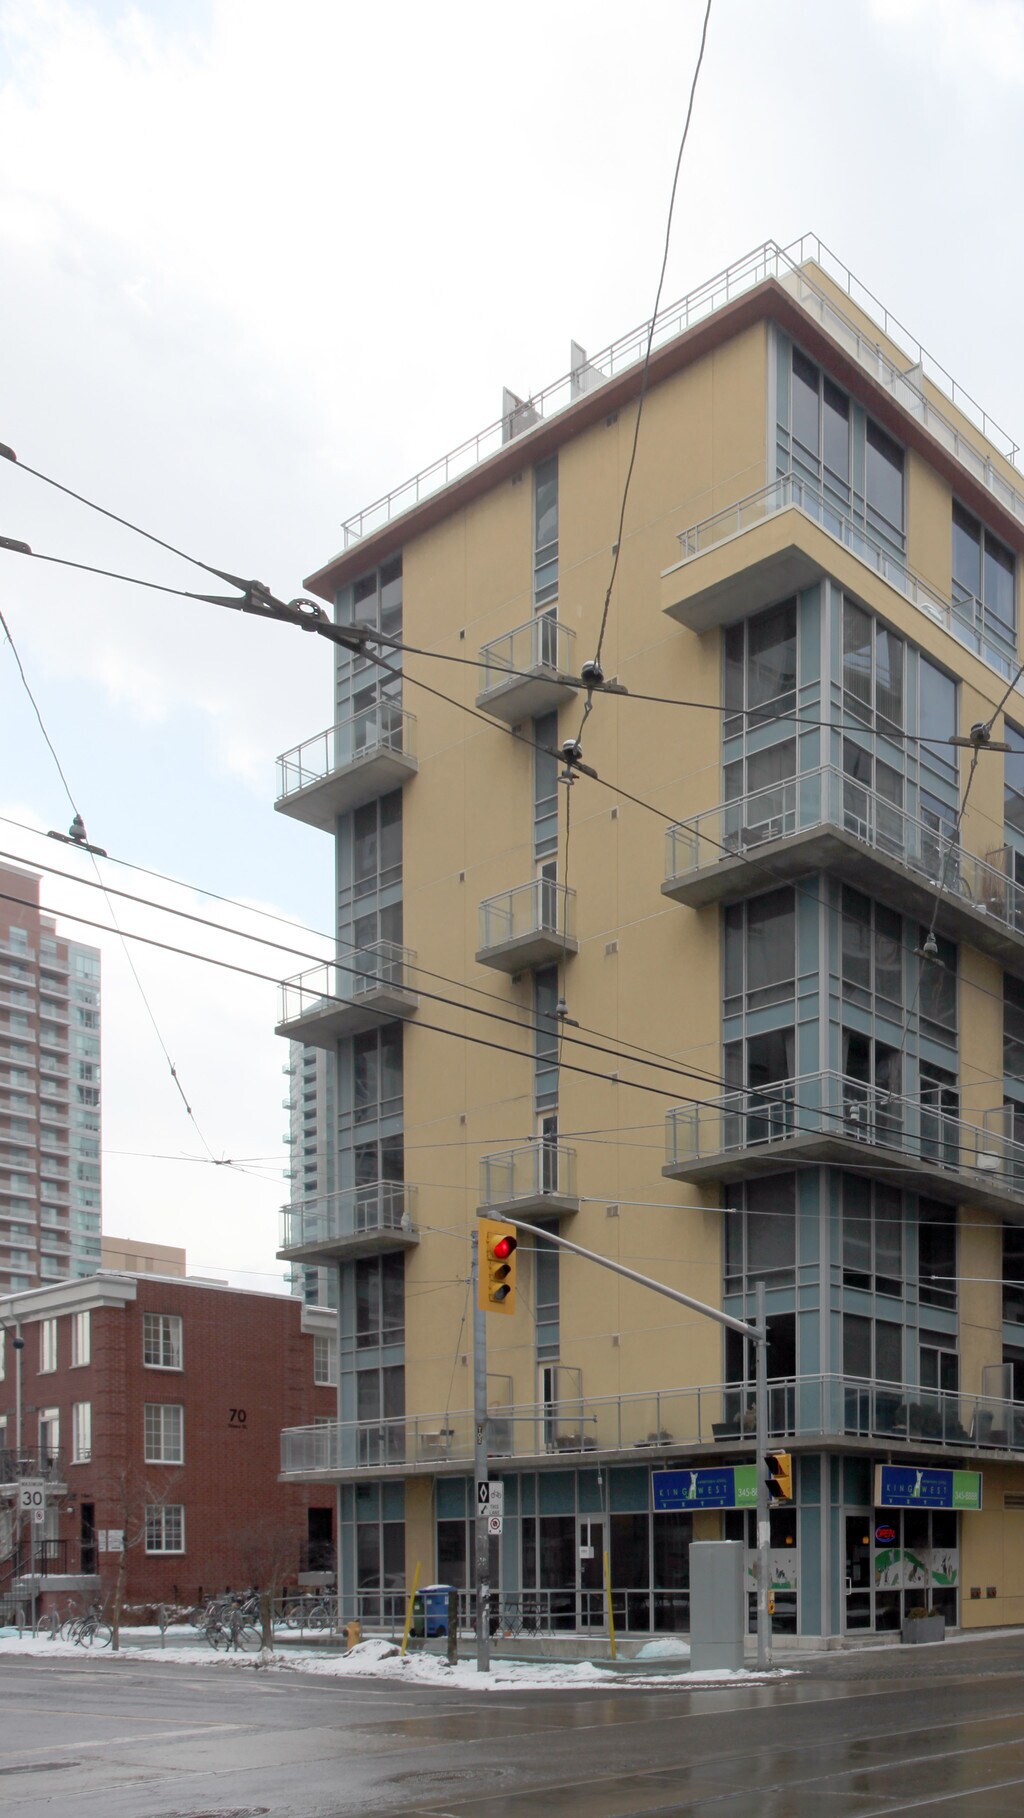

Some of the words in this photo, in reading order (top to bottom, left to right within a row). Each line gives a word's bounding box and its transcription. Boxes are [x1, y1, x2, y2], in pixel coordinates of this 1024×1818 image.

[228, 1408, 247, 1423] 70
[659, 1487, 688, 1497] KING
[698, 1484, 727, 1494] WEST
[886, 1484, 912, 1492] KING
[922, 1486, 946, 1495] WEST
[22, 1491, 43, 1506] 30
